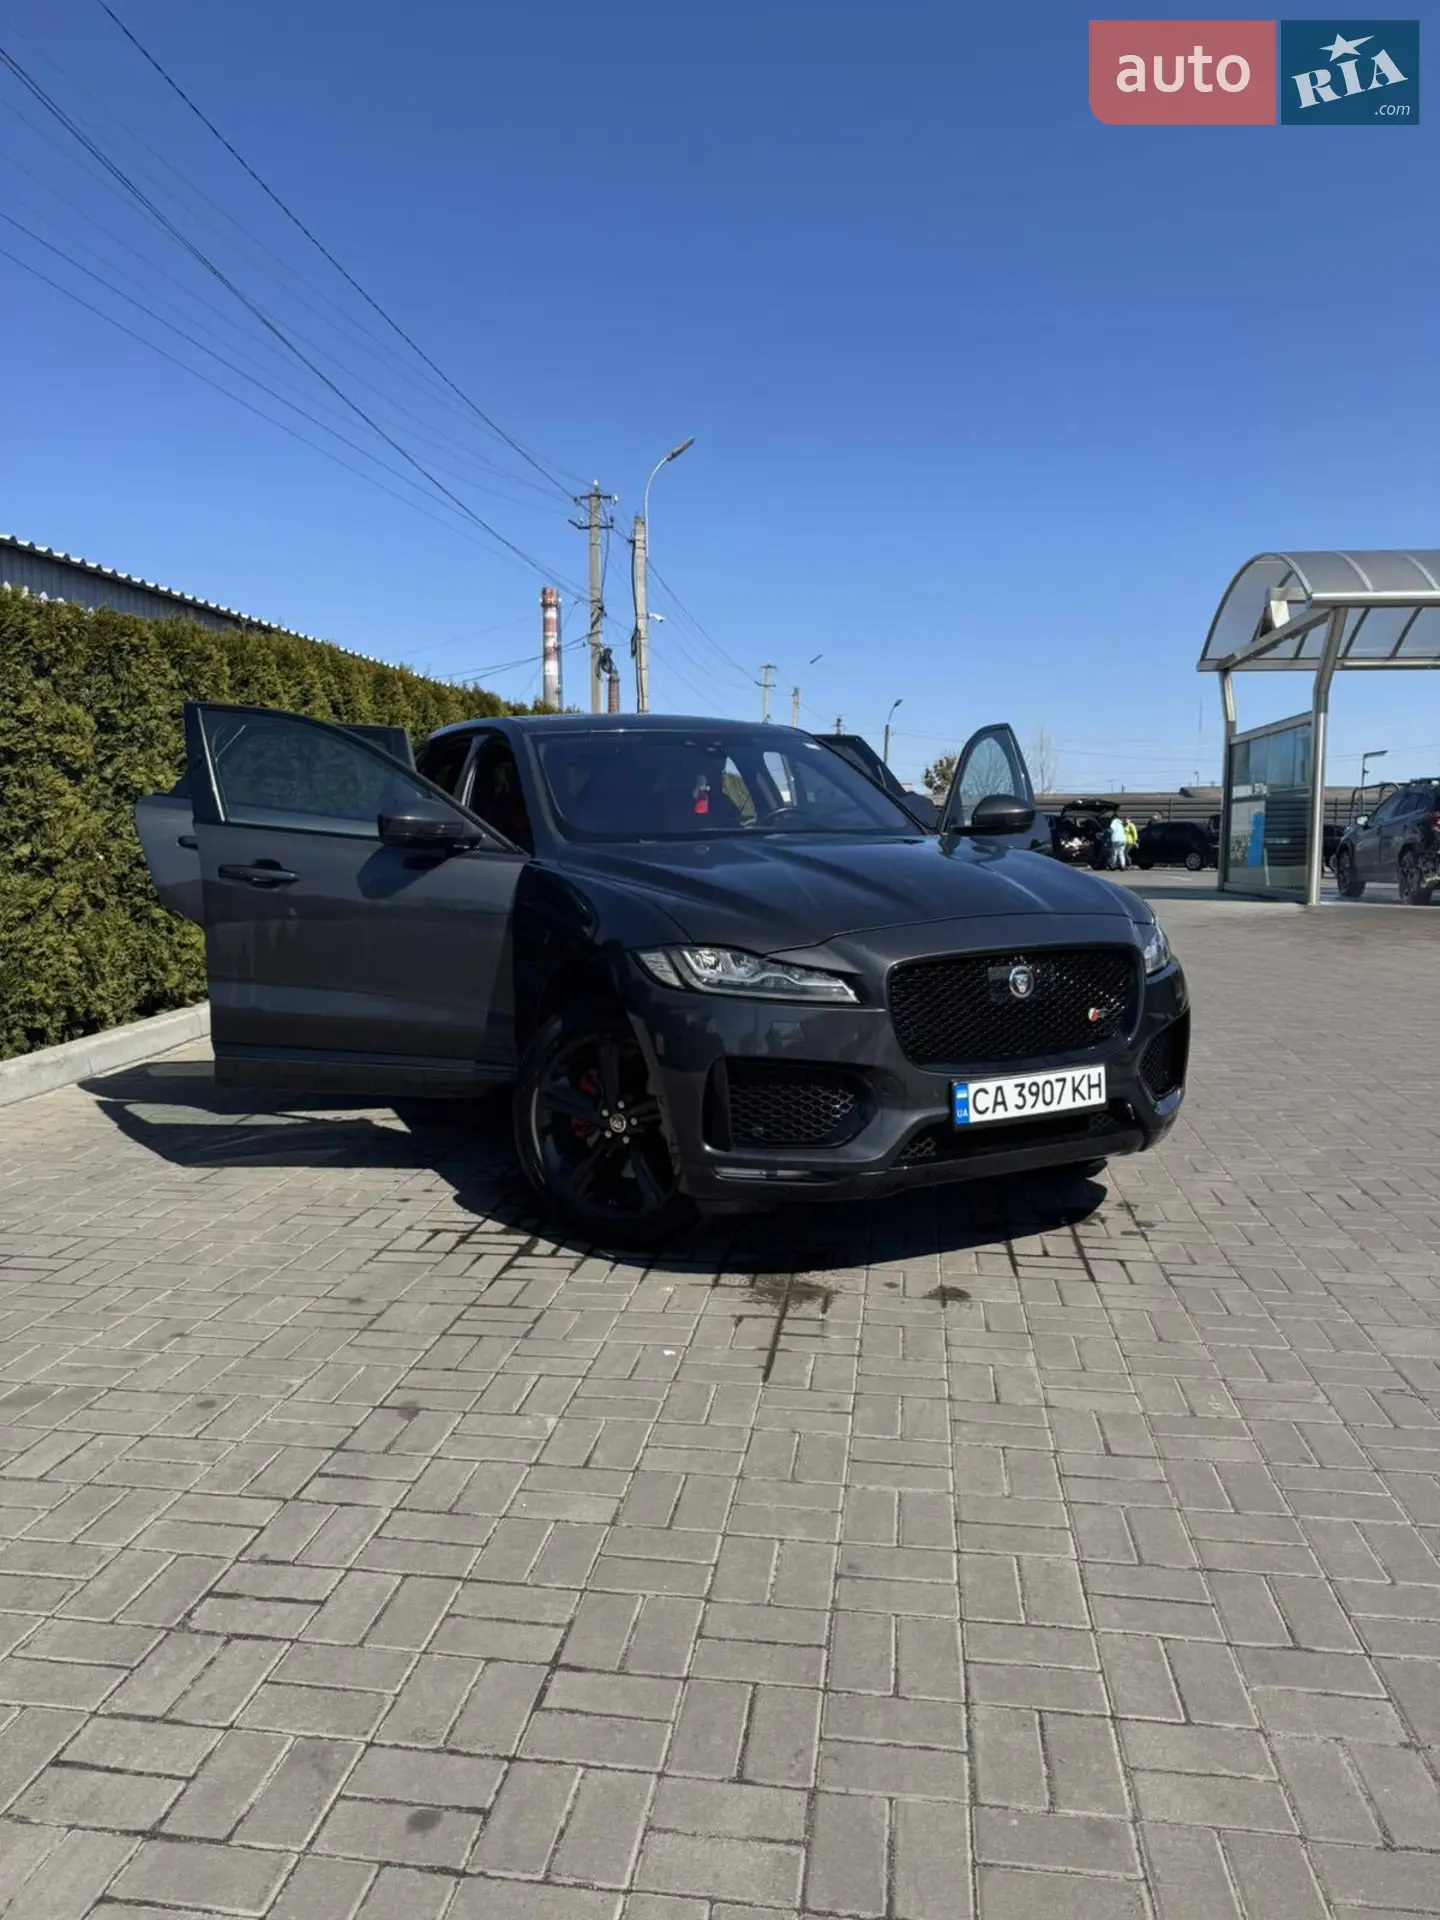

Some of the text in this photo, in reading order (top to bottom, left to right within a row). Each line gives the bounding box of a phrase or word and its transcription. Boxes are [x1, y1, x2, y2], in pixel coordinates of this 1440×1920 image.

[972, 1072, 1102, 1115] CA 3907 KH
[956, 1108, 969, 1118] UA
